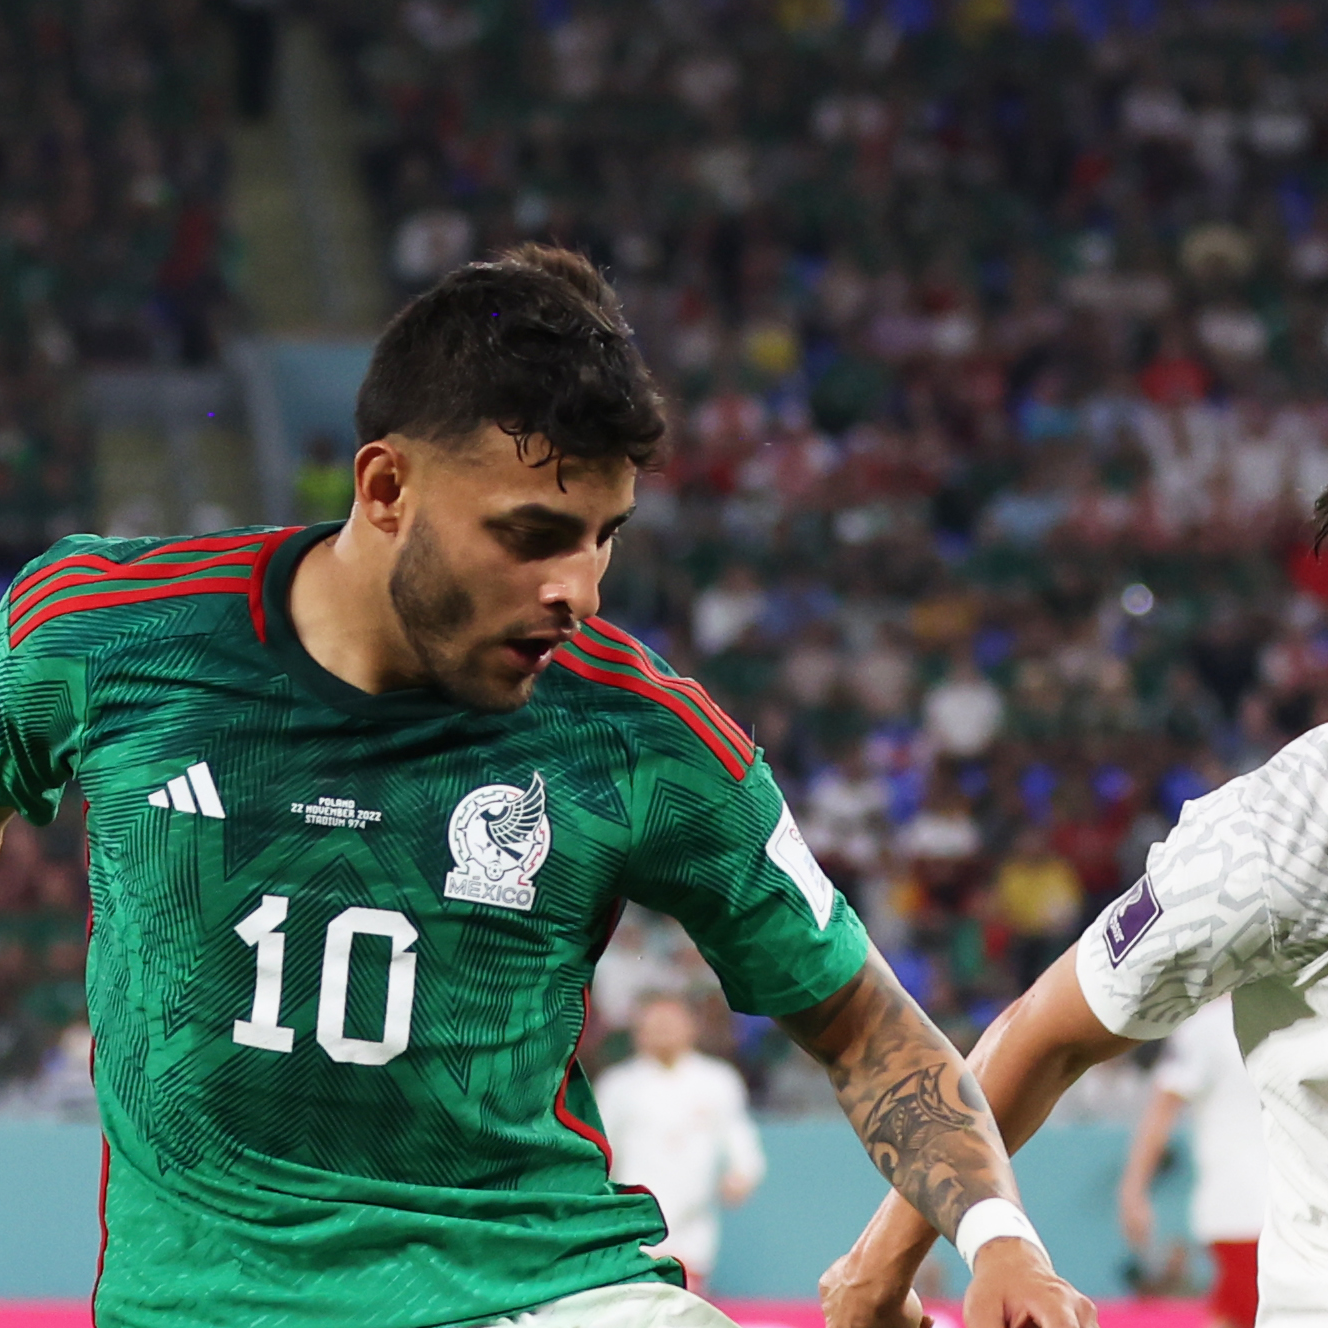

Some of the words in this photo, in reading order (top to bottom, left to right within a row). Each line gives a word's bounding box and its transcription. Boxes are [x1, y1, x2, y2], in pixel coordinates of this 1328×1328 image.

[291, 803, 304, 813] 22
[305, 805, 355, 818] NOVEMBER
[357, 810, 382, 822] 2022
[318, 797, 355, 809] POLAND
[305, 814, 346, 827] STADIUM
[348, 819, 366, 829] 974
[448, 876, 531, 906] MÉXICO
[233, 894, 419, 1066] 10
